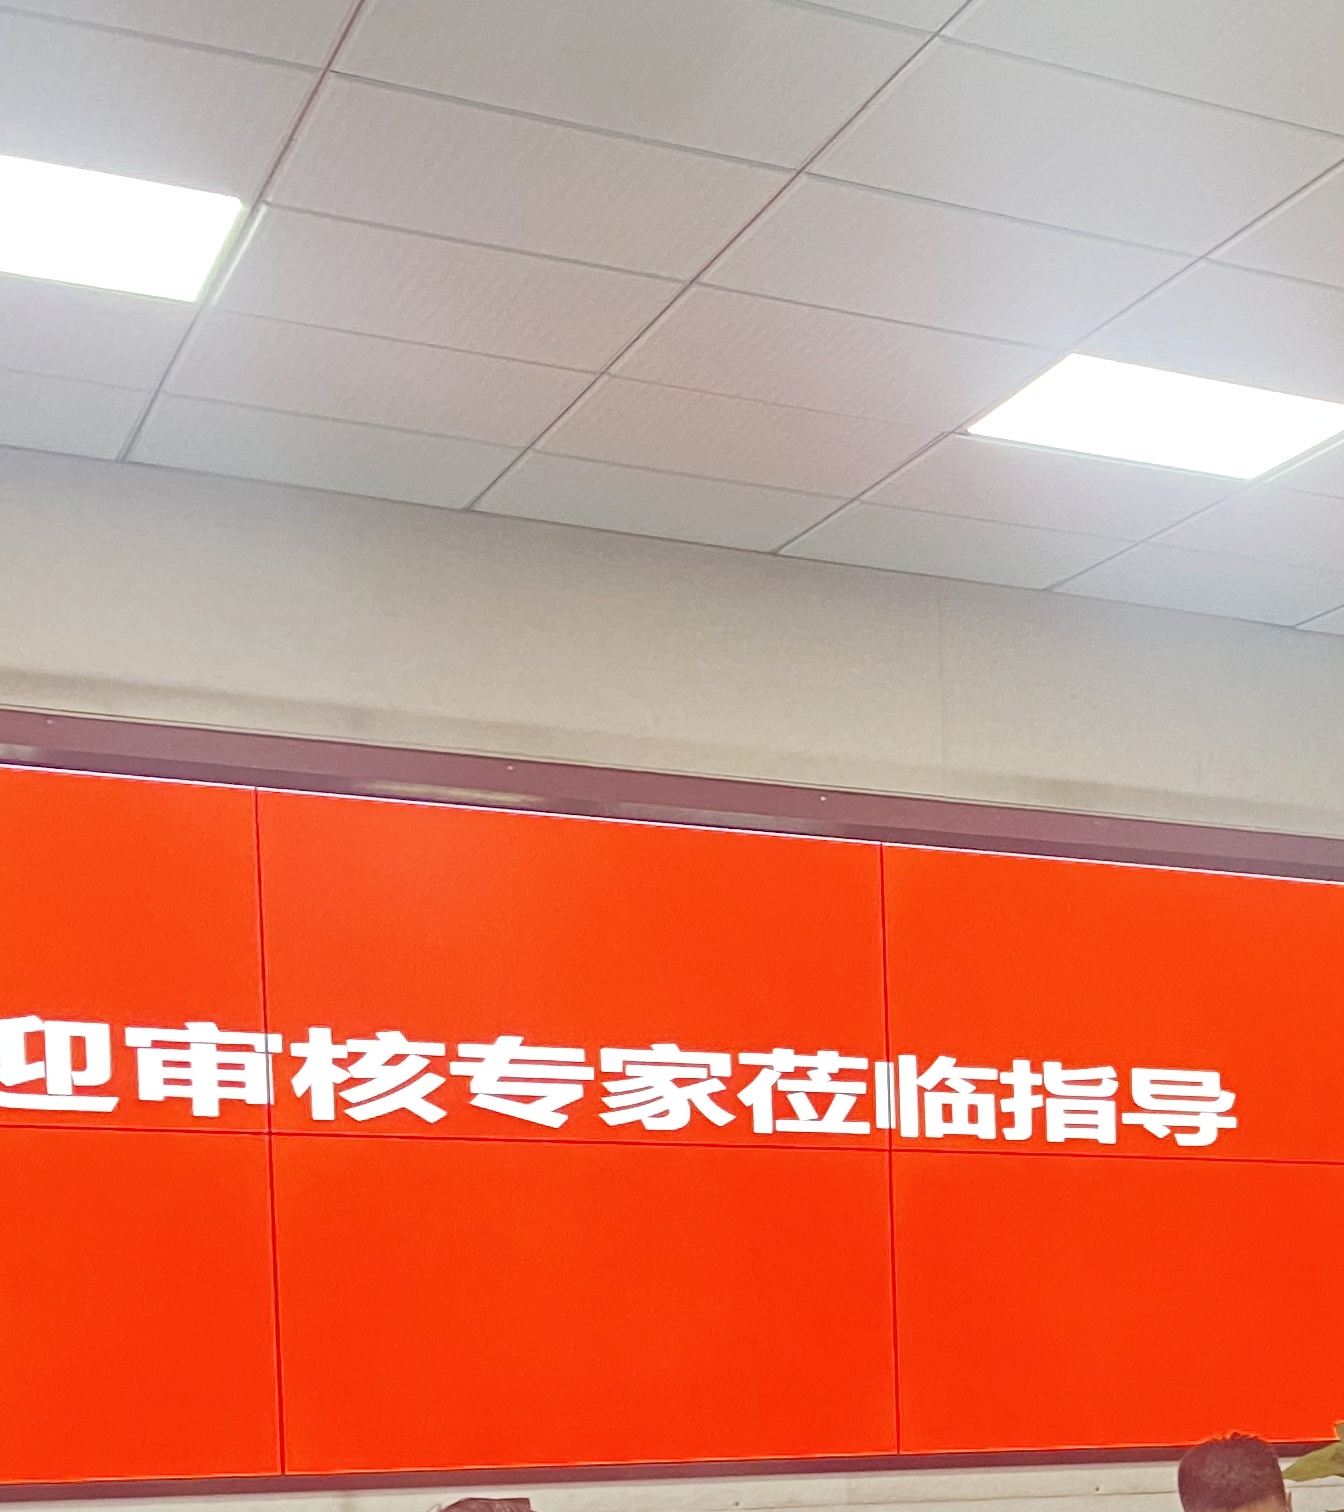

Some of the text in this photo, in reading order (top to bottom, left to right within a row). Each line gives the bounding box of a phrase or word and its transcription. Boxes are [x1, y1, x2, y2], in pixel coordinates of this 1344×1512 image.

[0, 1014, 1238, 1147] 迎审核专家莅临指导
